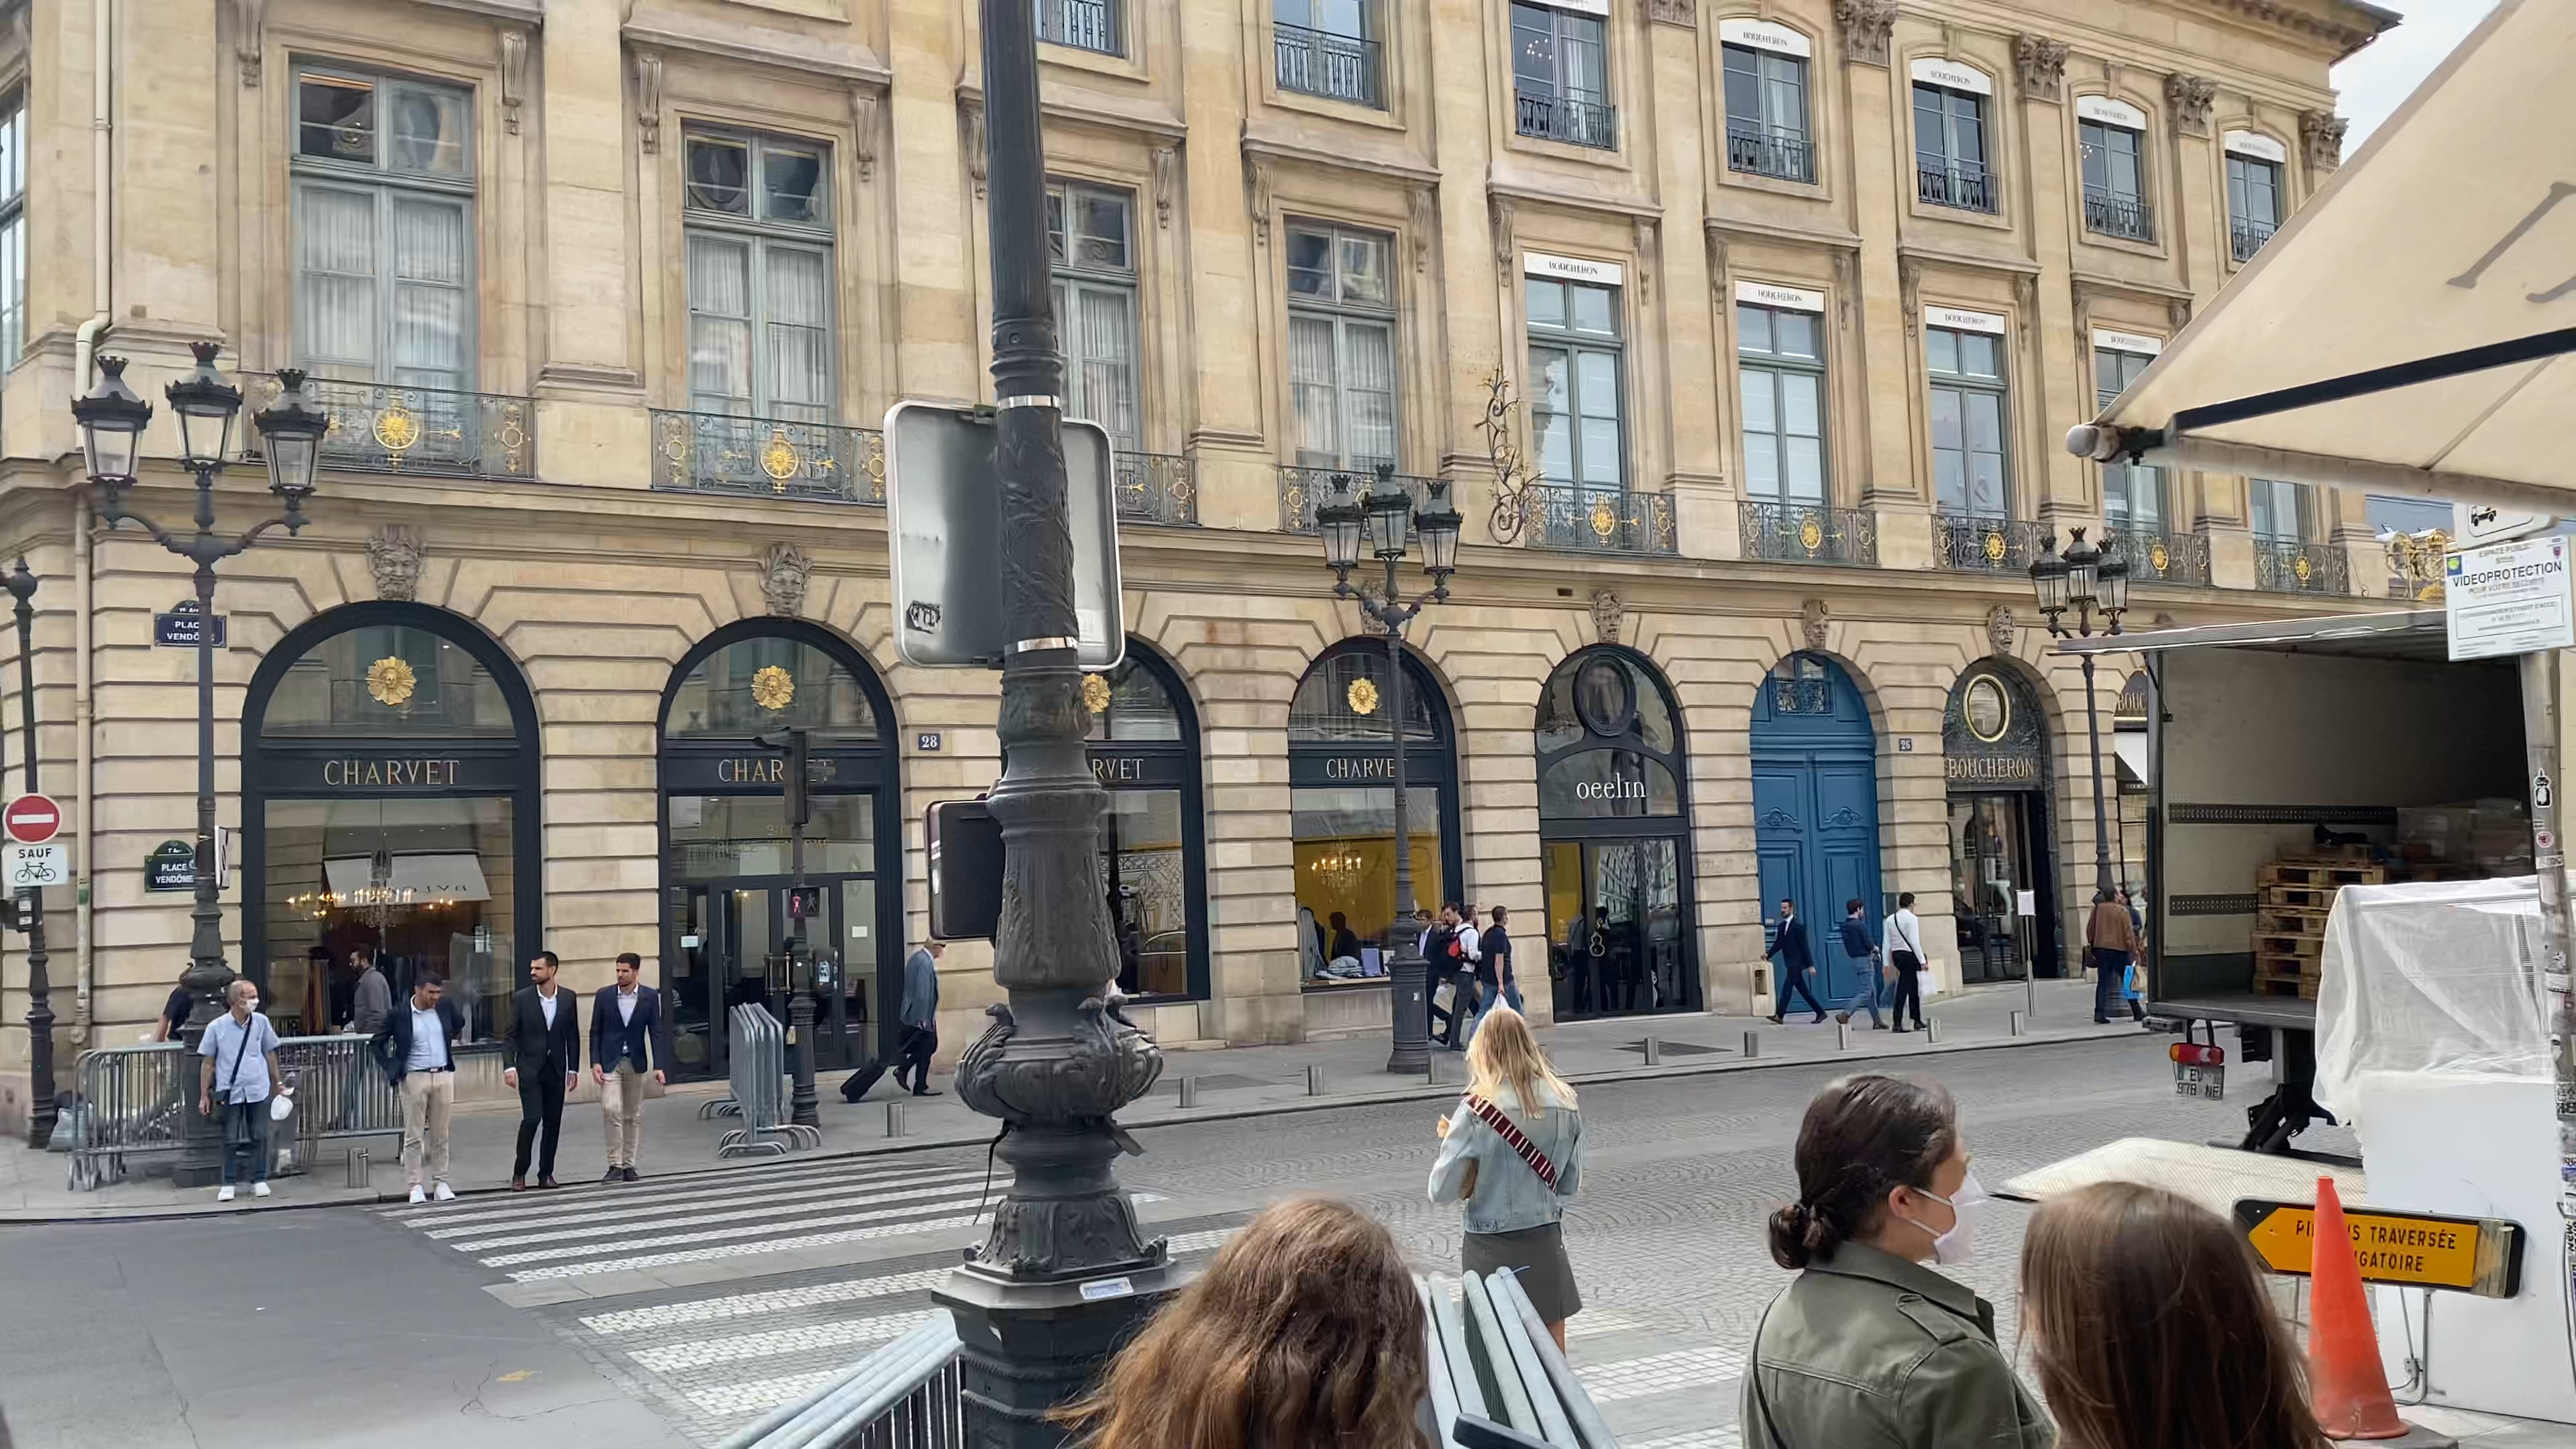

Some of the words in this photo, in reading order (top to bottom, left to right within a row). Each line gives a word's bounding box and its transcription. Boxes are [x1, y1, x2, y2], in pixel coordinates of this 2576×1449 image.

[2453, 561, 2562, 587] VIDEOPROTECTION
[174, 621, 199, 629] PLAC
[166, 631, 199, 641] VENDÔ
[921, 735, 937, 748] 28
[324, 760, 460, 786] CHARVET
[1948, 757, 2034, 778] BOUCHERON
[18, 847, 52, 859] SAUF
[161, 863, 187, 872] PLACE
[2370, 1226, 2457, 1250] TRAVERSÉE
